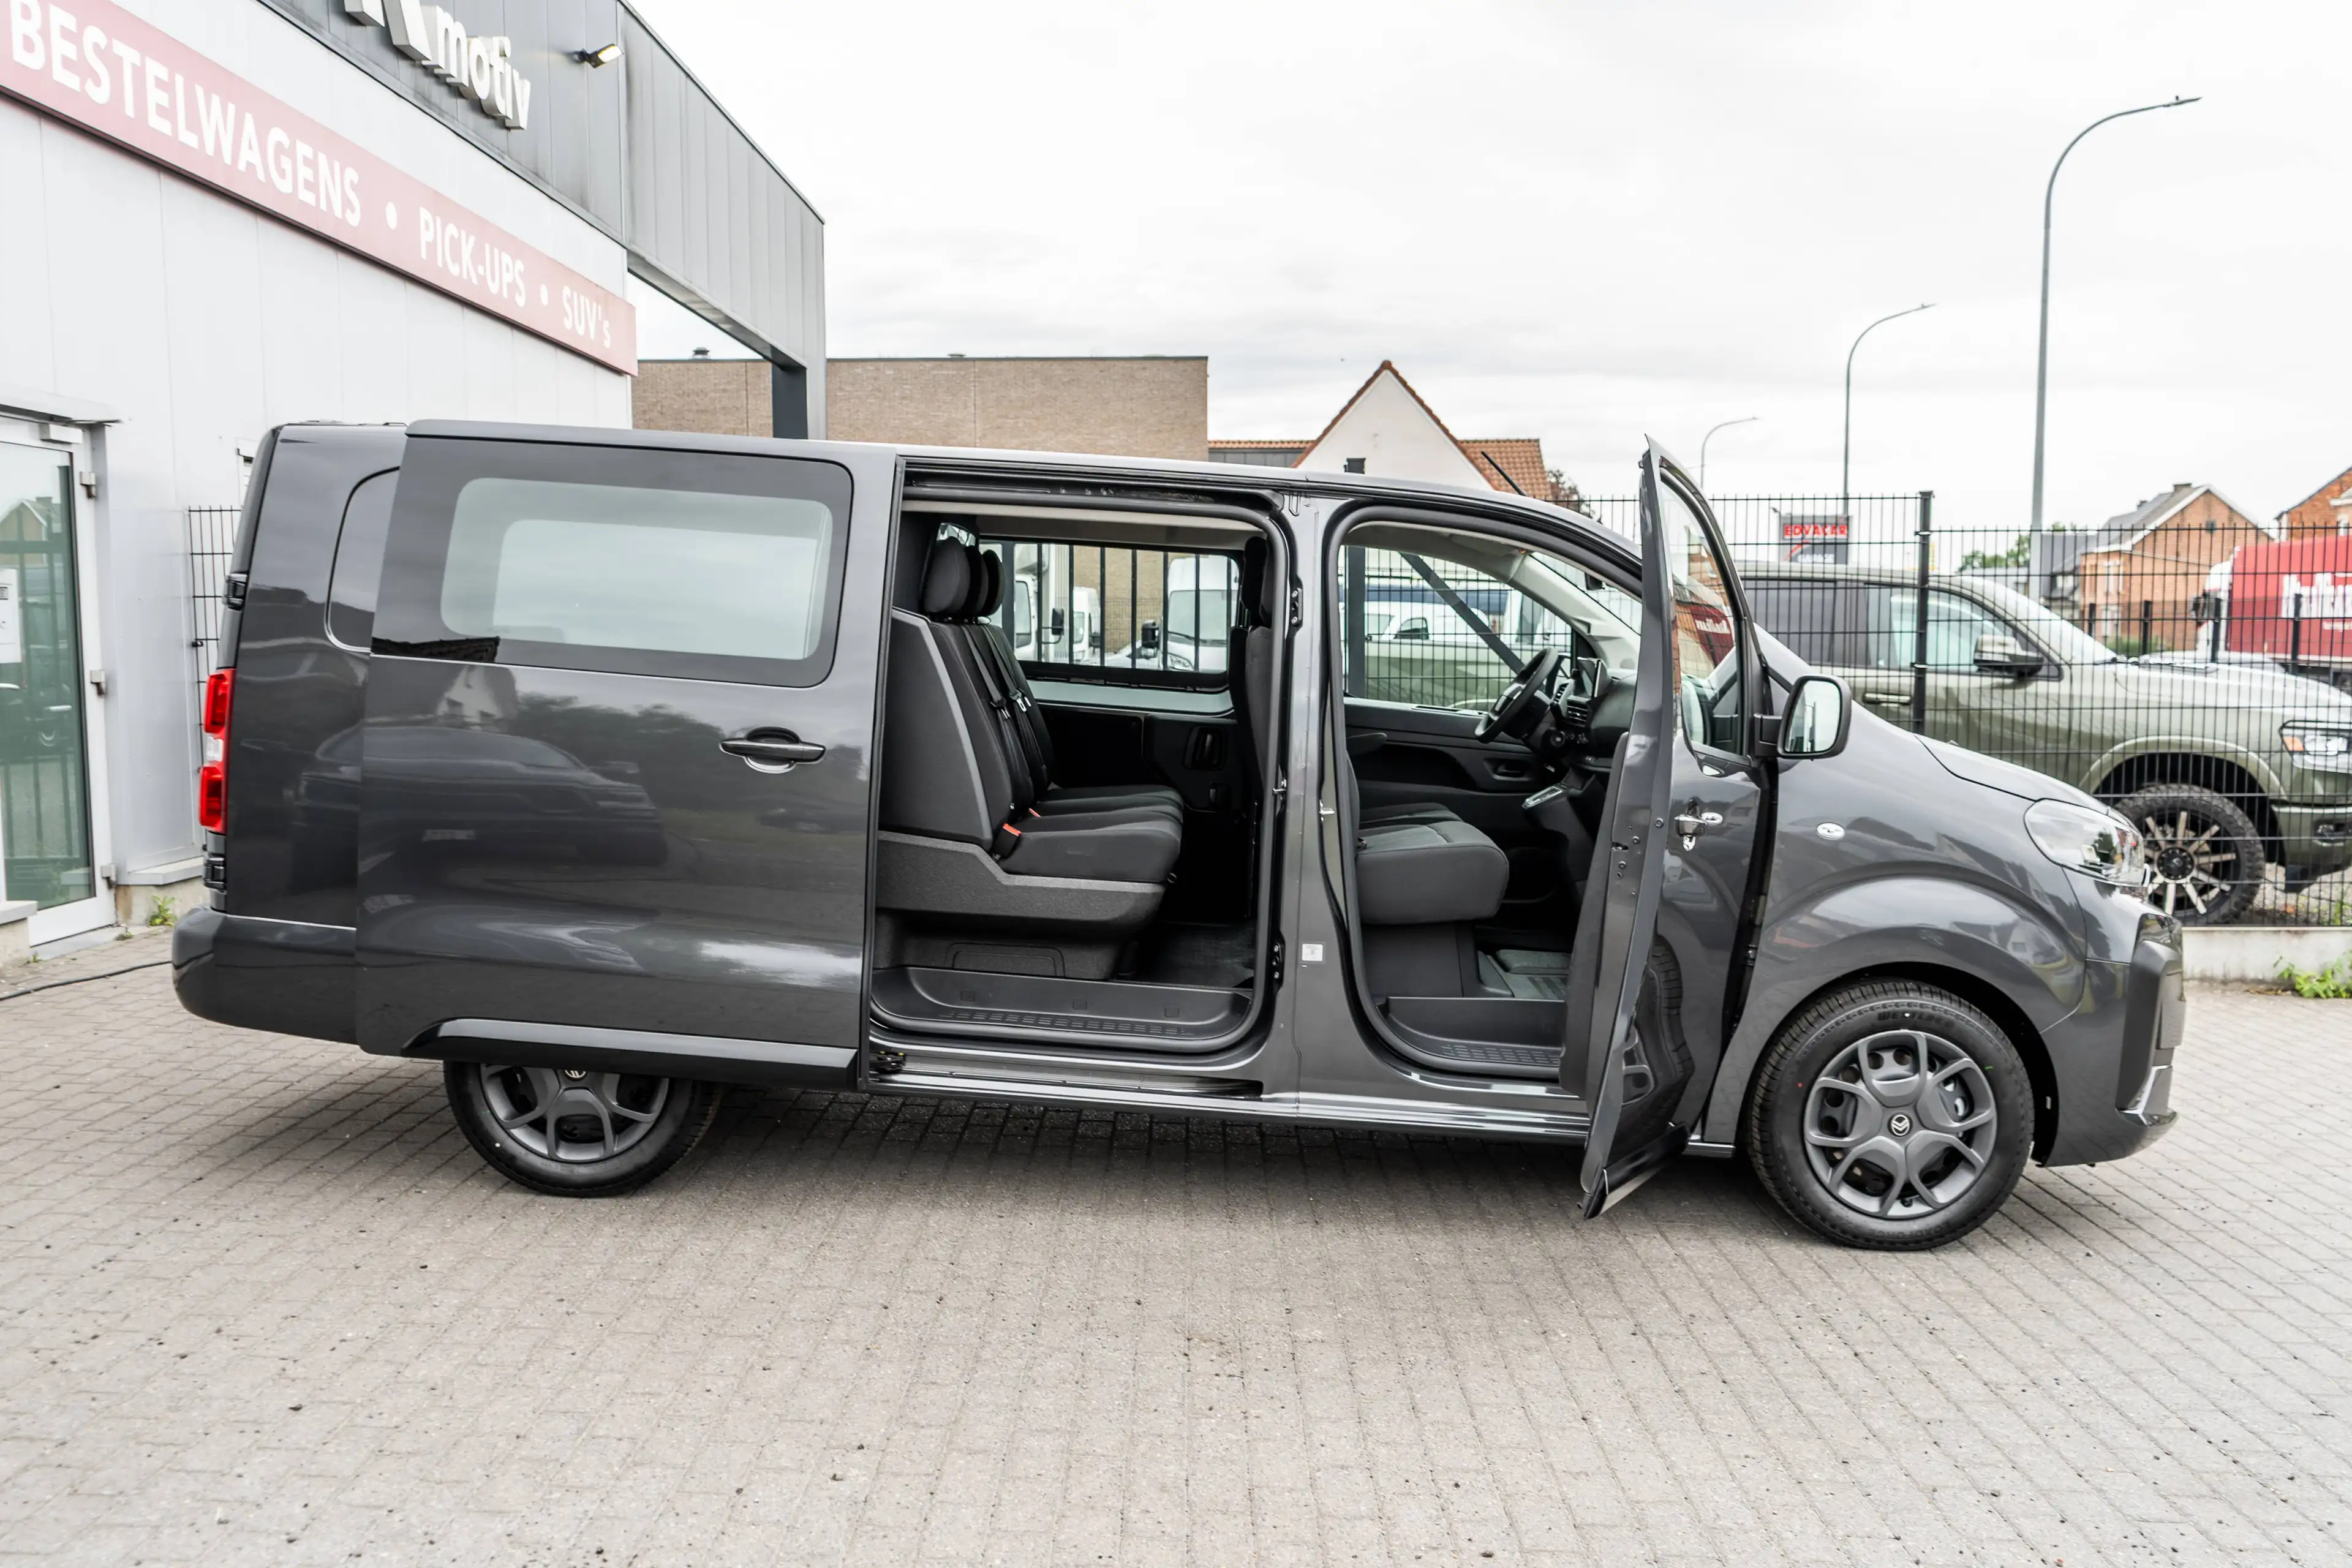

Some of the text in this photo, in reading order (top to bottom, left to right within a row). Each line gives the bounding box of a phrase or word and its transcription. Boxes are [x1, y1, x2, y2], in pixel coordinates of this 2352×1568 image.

[10, 0, 361, 227] BESTELWAGENS
[419, 206, 526, 307] PICK-UPS
[562, 285, 611, 349] SUV's
